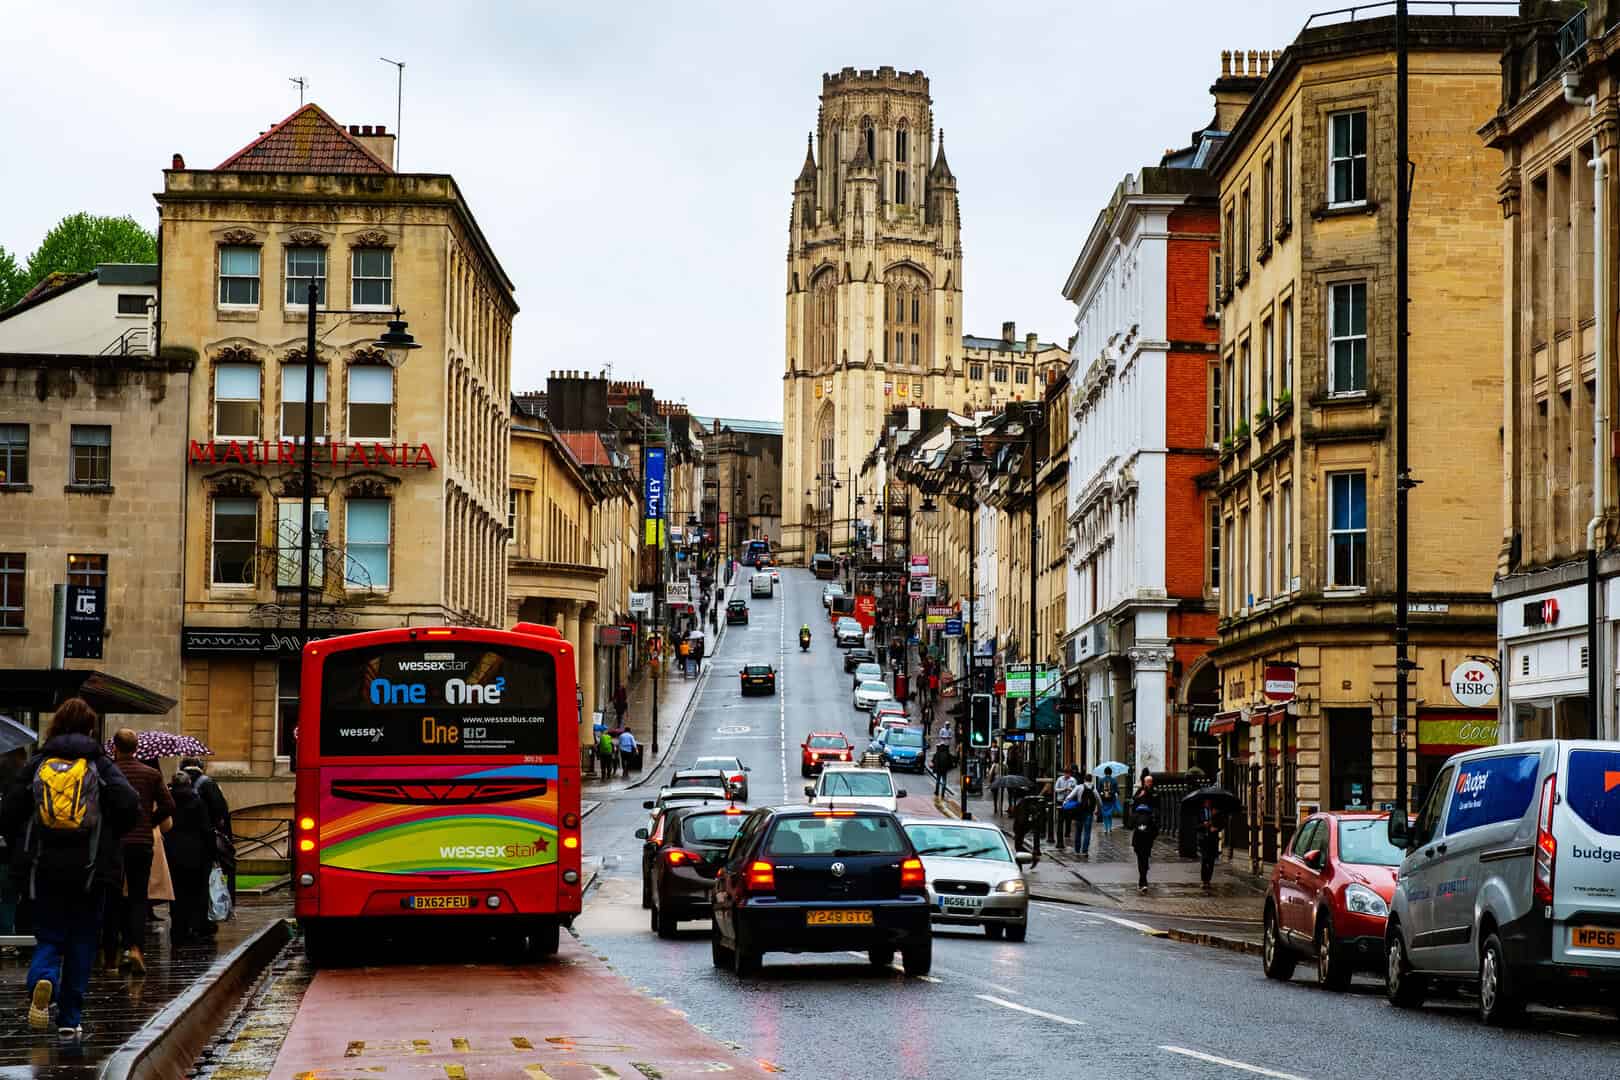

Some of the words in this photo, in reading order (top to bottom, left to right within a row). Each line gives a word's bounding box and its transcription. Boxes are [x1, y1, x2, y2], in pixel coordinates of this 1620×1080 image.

[398, 658, 468, 671] wessexstar
[370, 678, 426, 704] One
[1456, 682, 1494, 695] HSBC
[422, 717, 458, 743] One
[439, 843, 537, 858] wessexstar
